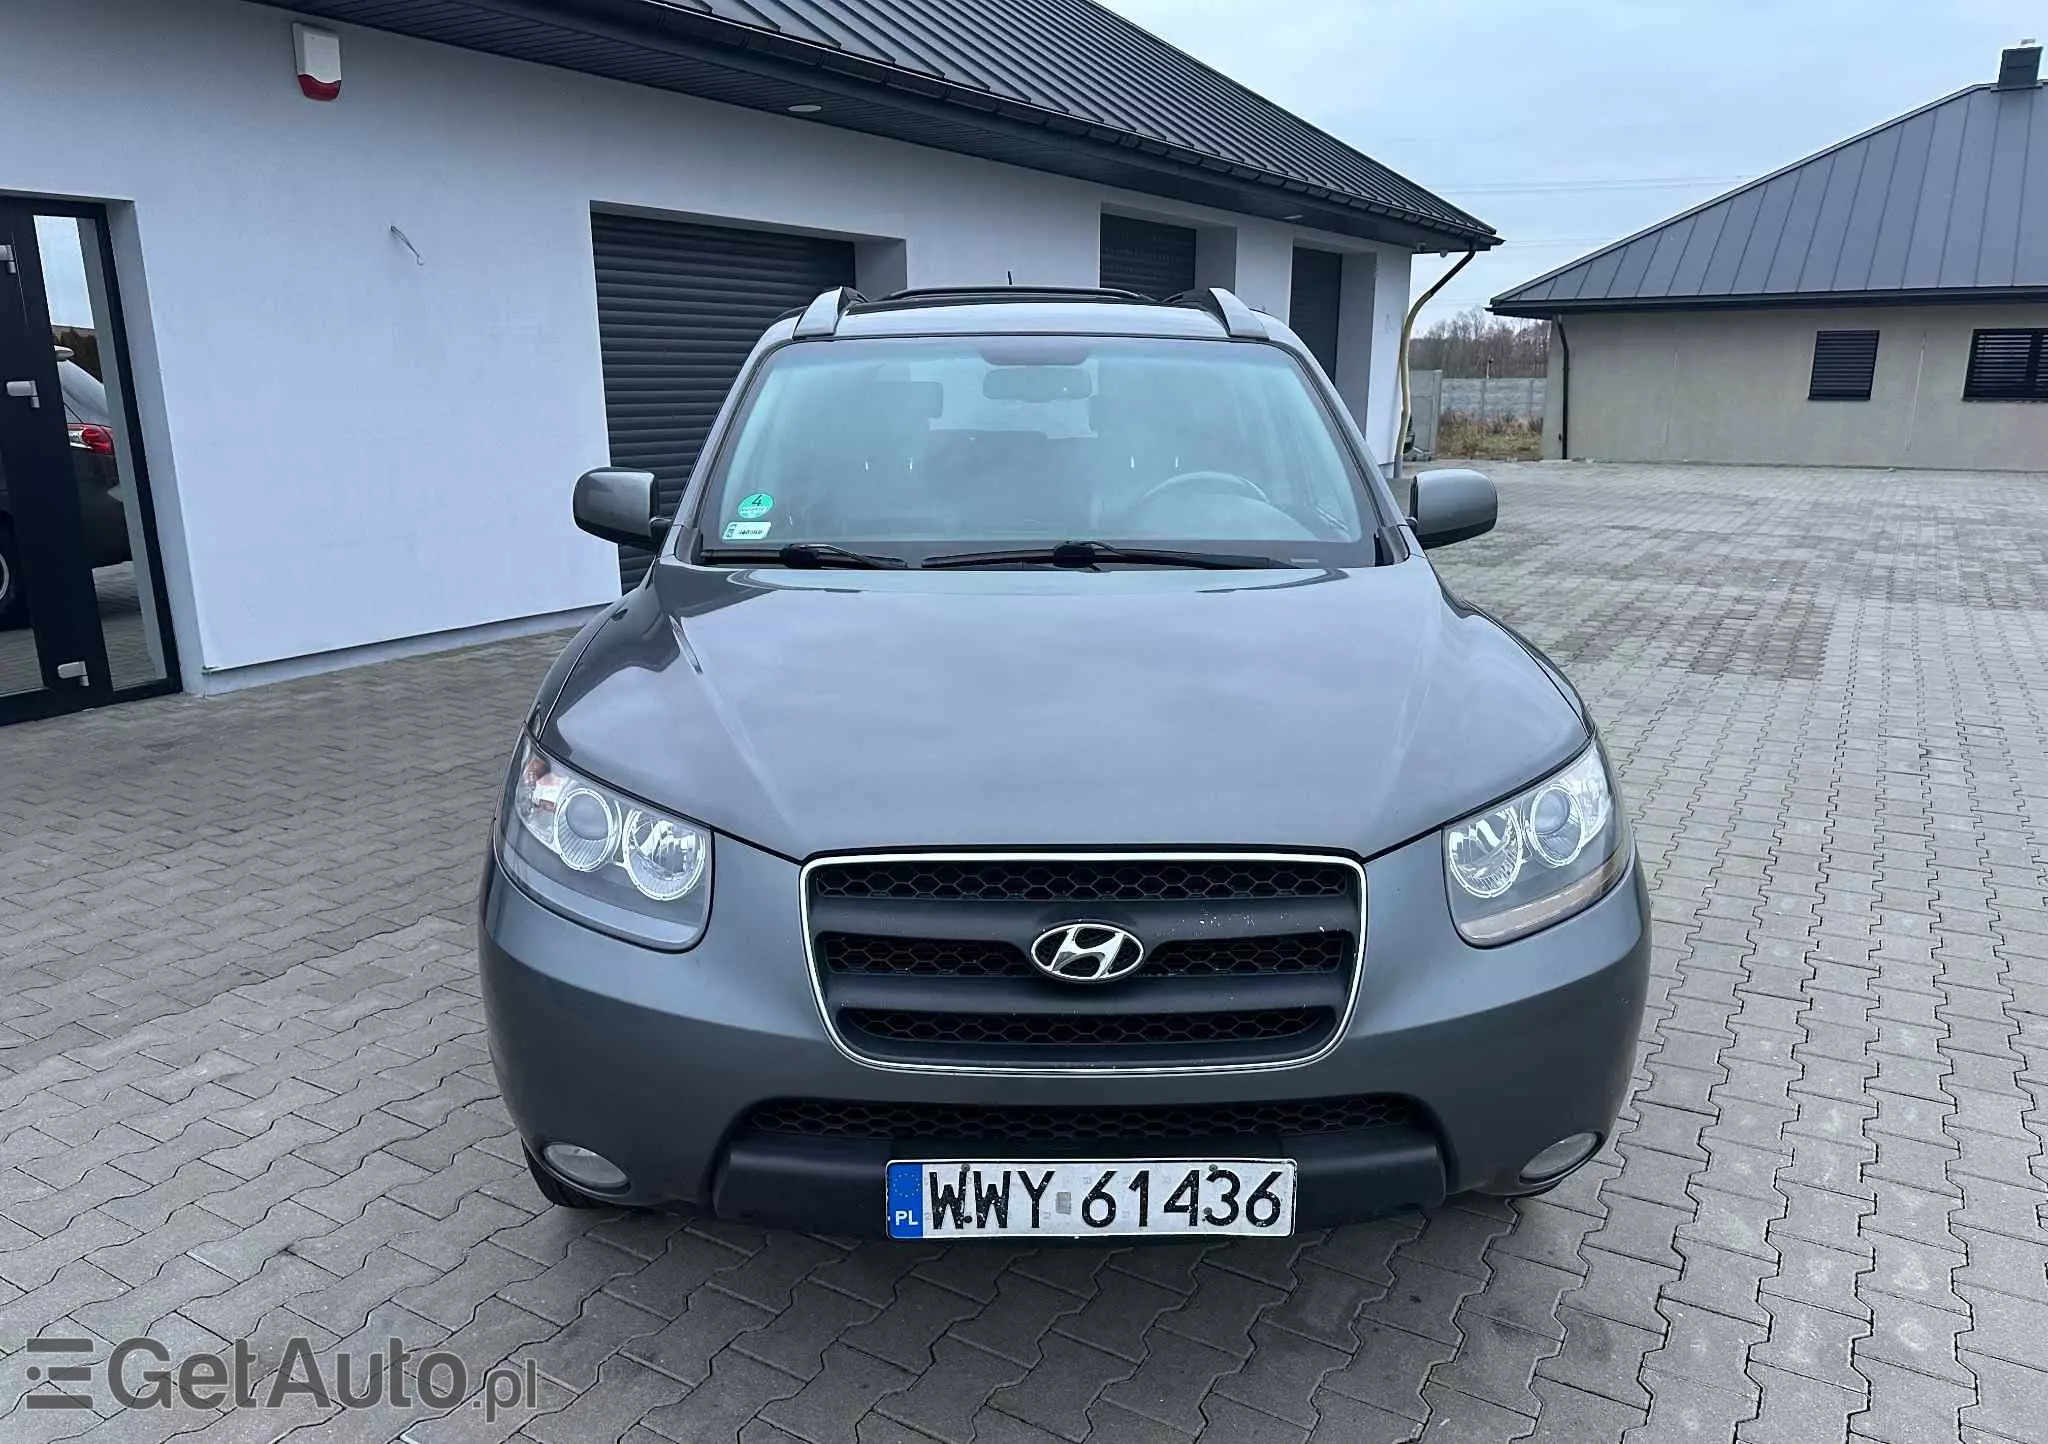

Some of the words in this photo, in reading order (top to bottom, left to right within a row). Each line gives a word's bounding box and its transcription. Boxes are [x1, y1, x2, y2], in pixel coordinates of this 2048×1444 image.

[752, 494, 763, 506] 4
[929, 1169, 1056, 1230] WWY
[1081, 1168, 1284, 1229] 61436
[895, 1210, 919, 1226] PL
